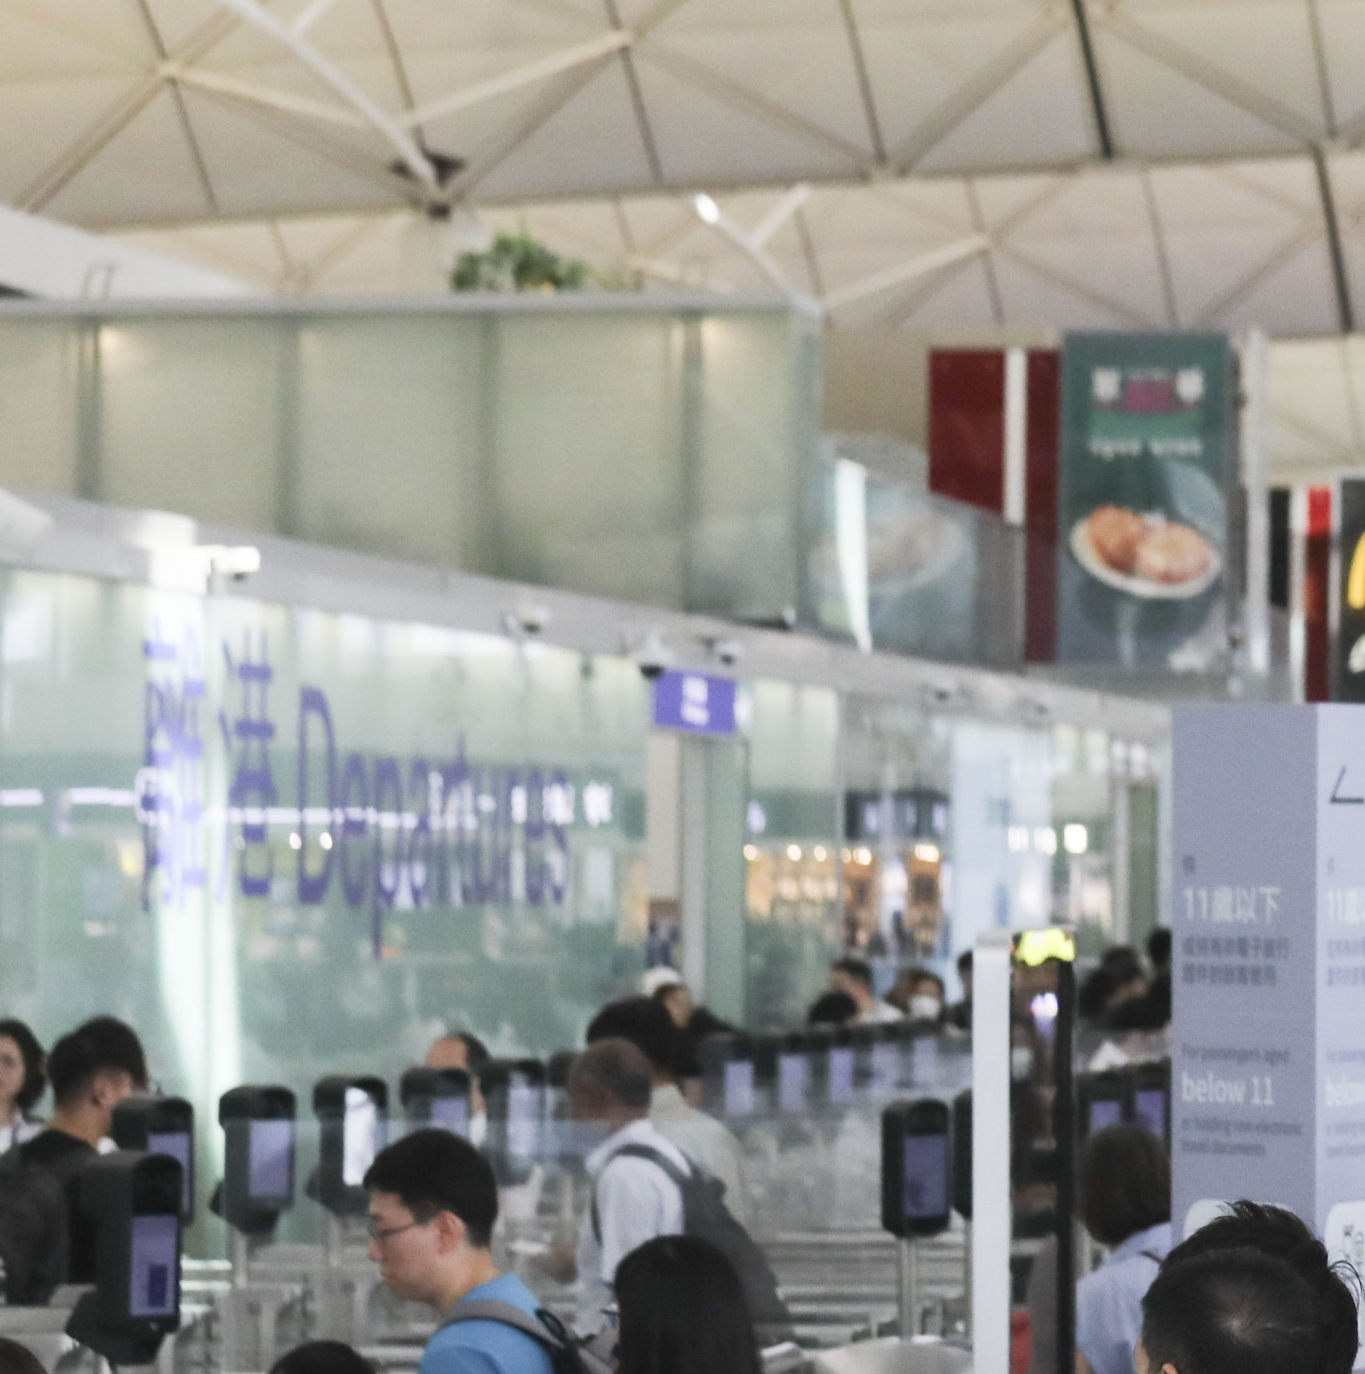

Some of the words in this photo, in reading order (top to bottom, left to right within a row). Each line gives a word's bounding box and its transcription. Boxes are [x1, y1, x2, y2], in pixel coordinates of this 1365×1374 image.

[1181, 1071, 1245, 1102] below
[1251, 1076, 1273, 1105] 11
[1326, 1075, 1365, 1106] below
